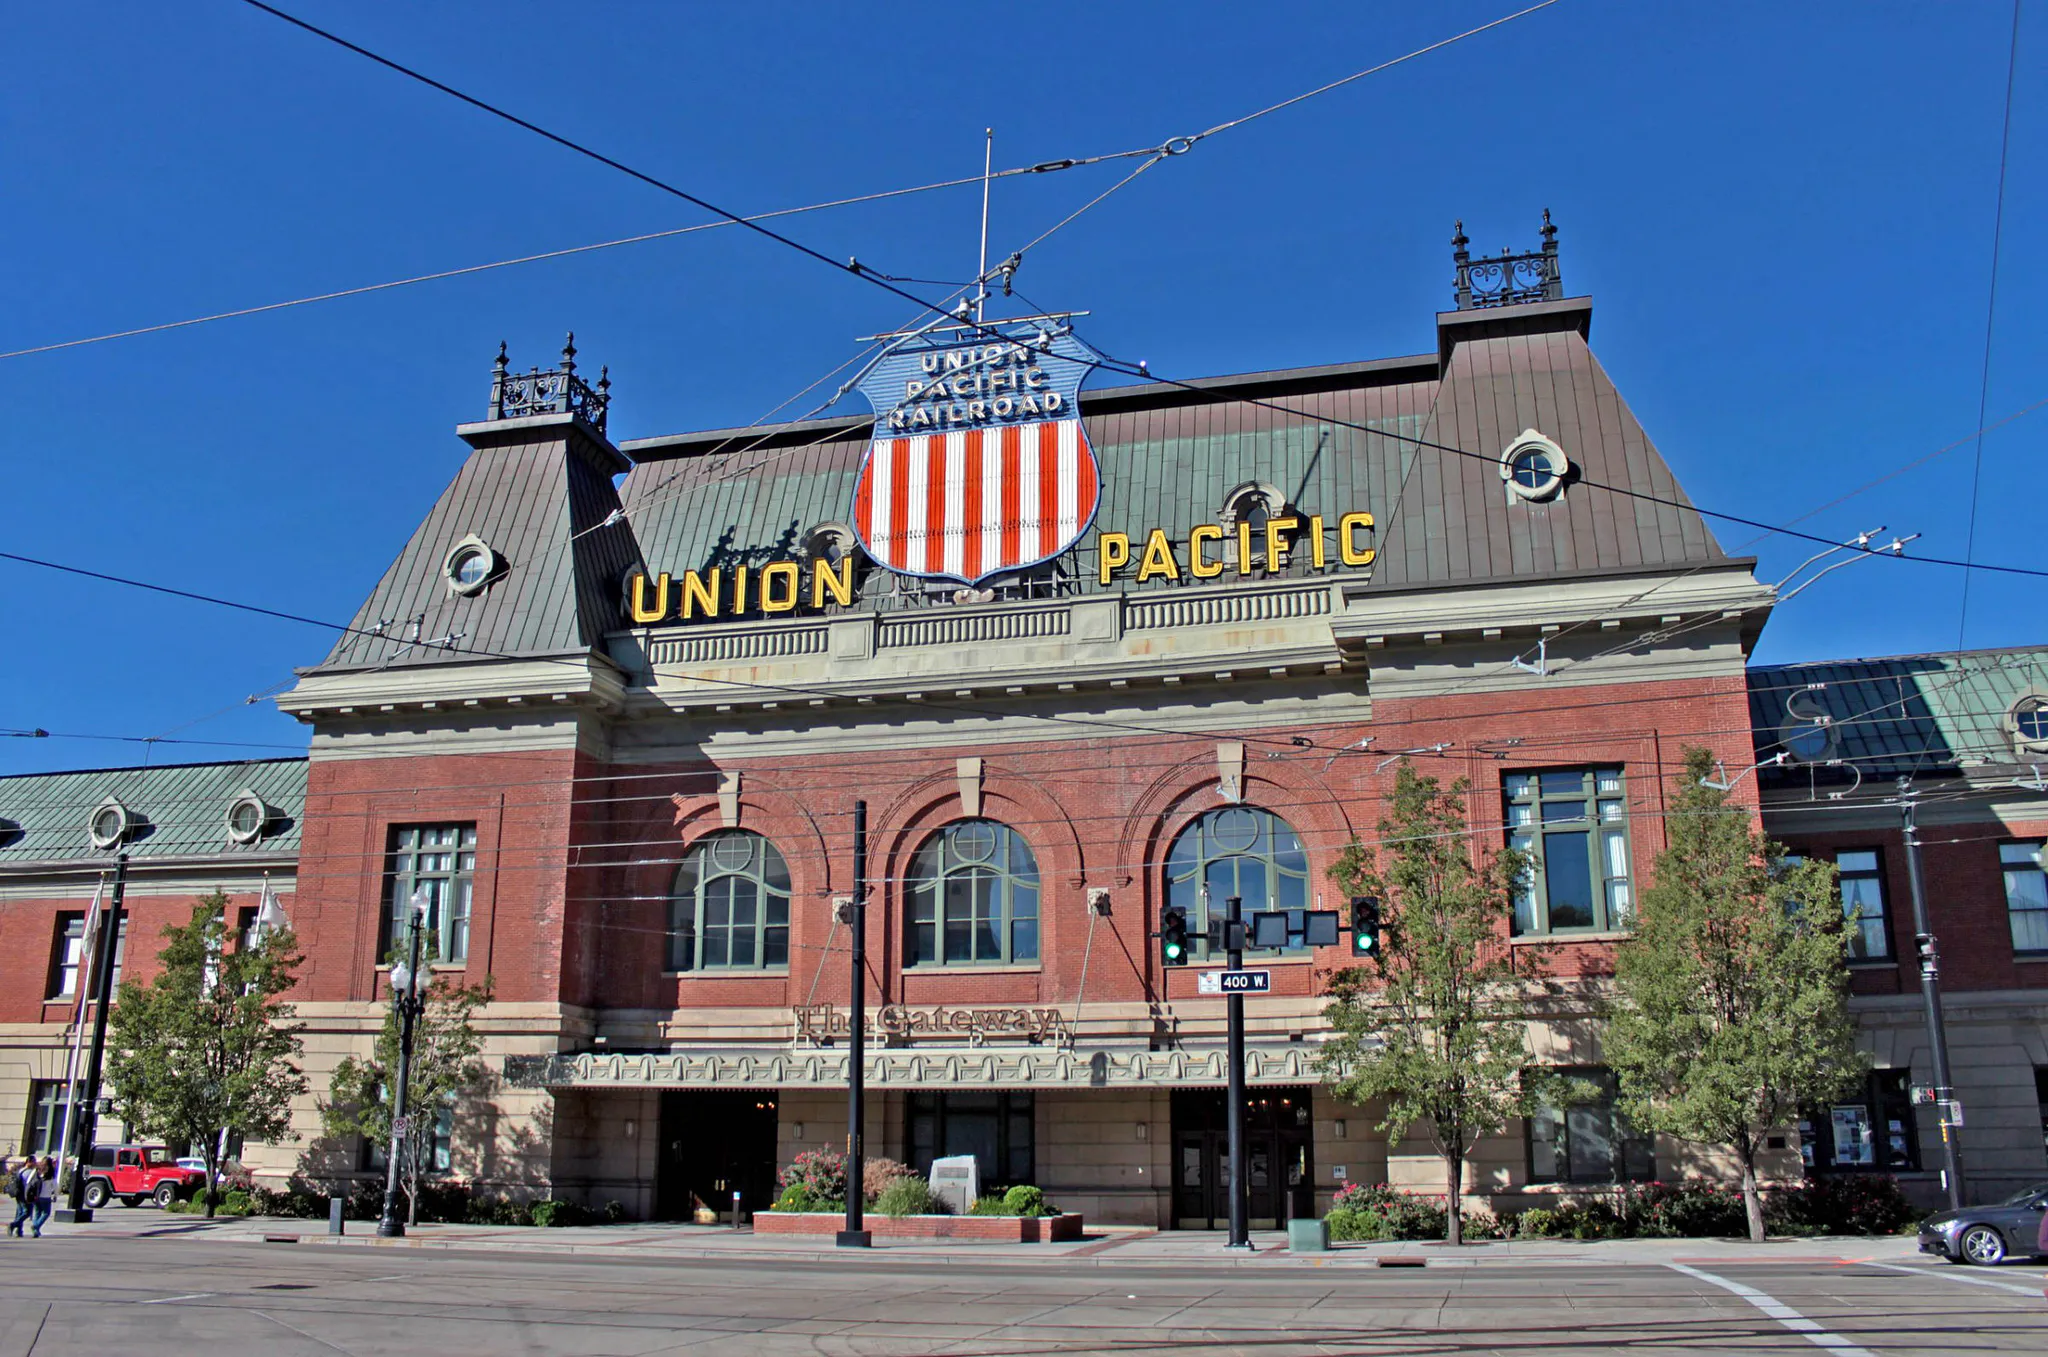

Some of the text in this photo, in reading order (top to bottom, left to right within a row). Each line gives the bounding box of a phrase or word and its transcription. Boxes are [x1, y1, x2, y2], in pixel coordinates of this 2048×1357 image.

[921, 343, 1029, 372] UNION
[906, 366, 1042, 398] PACIFIC
[888, 392, 1062, 428] RAILROAD
[631, 511, 1376, 623] UNION PACIFIC
[1223, 976, 1248, 988] 400
[877, 1003, 1061, 1042] Gateway
